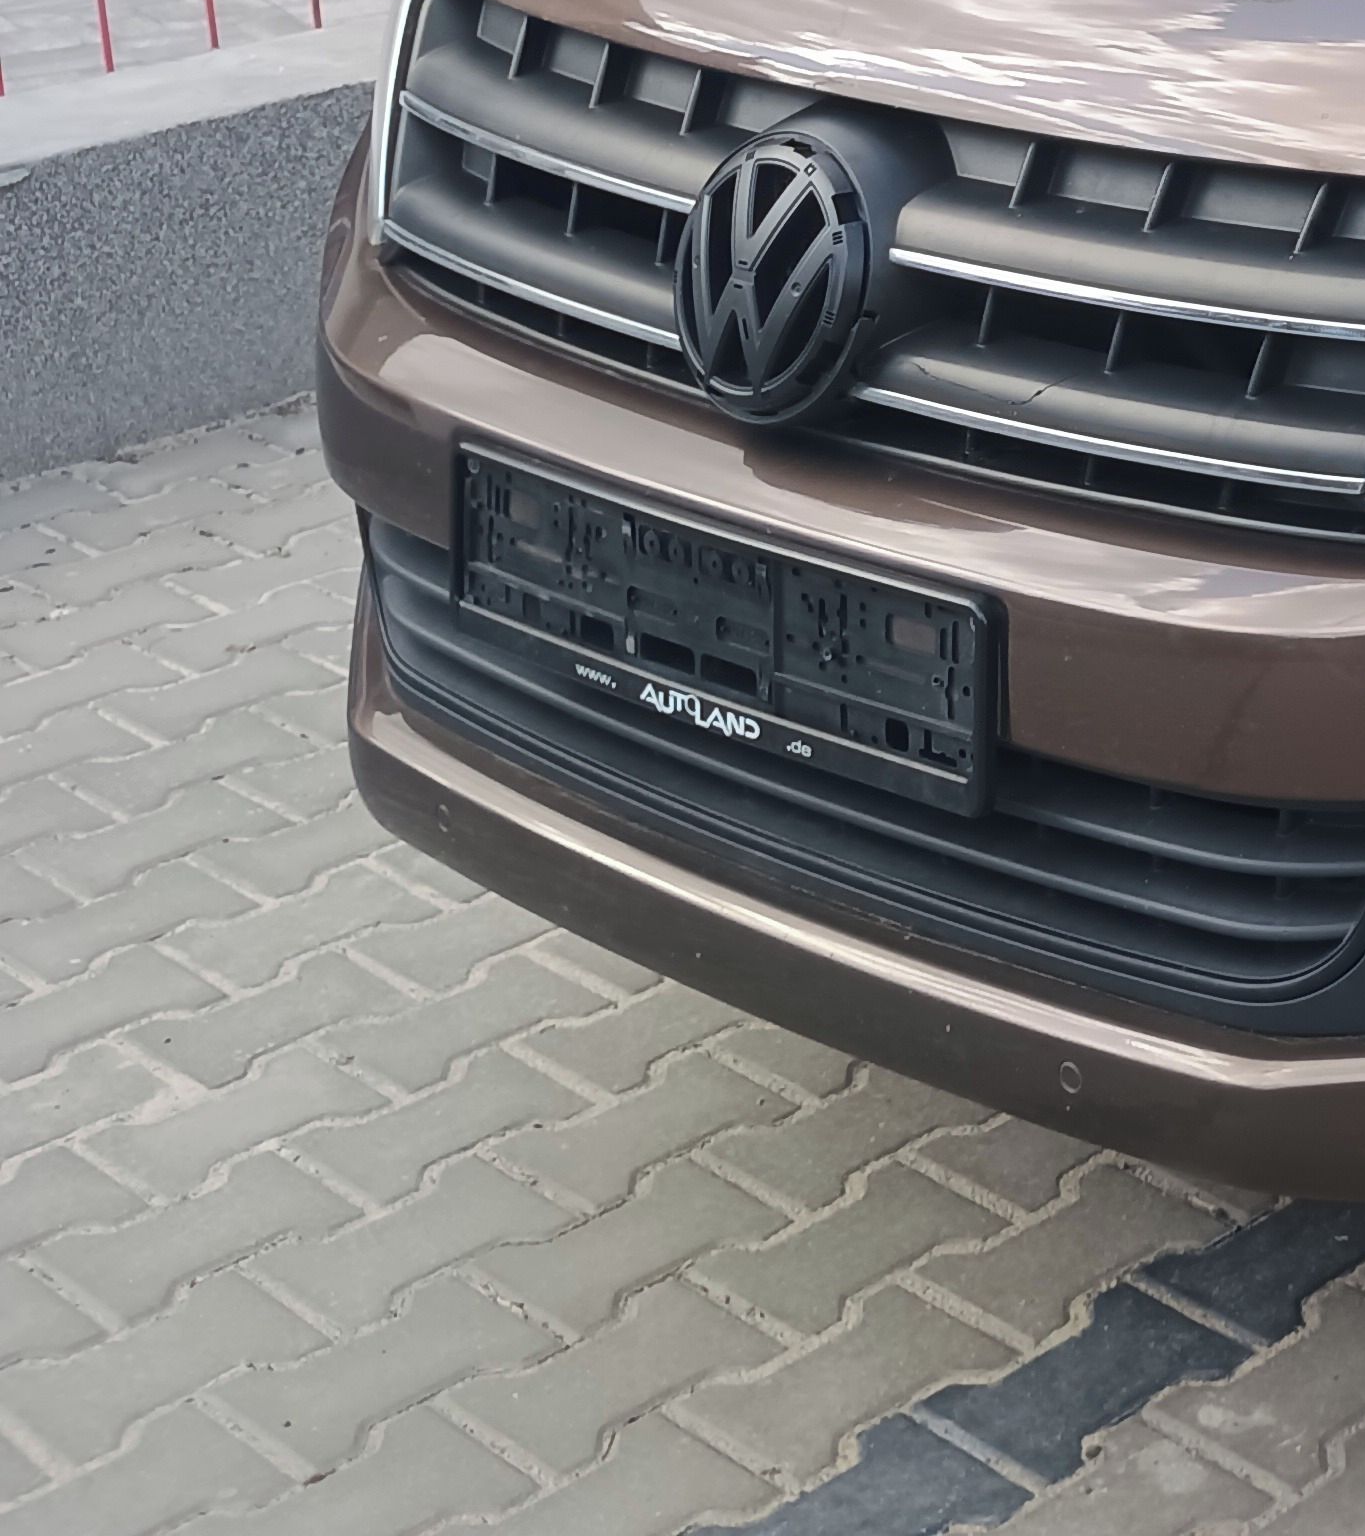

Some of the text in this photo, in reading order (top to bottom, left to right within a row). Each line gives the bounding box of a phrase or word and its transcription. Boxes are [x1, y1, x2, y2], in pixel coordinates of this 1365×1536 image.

[575, 664, 812, 758] www. AUTOLAND .de
